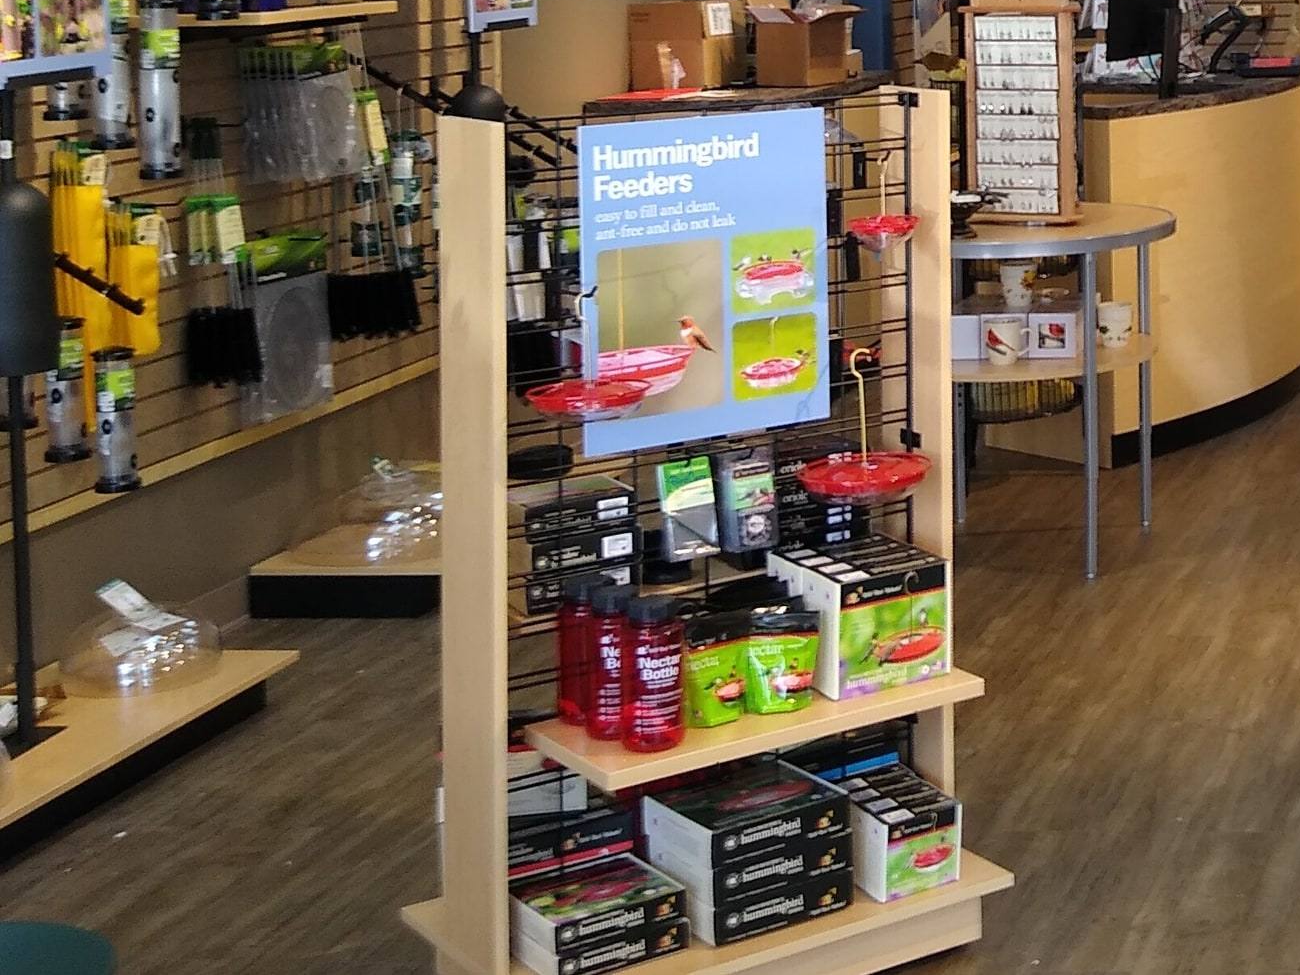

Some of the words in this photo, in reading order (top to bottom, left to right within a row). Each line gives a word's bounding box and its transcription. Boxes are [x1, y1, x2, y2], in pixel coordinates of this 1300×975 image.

[592, 131, 760, 172] Hummingbird
[593, 170, 694, 202] Feeders
[594, 211, 624, 225] easy
[624, 209, 638, 221] to
[640, 203, 658, 219] fill
[660, 201, 684, 217] and
[595, 223, 646, 241] ant-free
[646, 220, 670, 235] and
[671, 216, 689, 233] do
[690, 218, 710, 230] not
[711, 213, 737, 227] leak
[637, 653, 682, 670] Nectar
[641, 665, 680, 681] Bottle
[741, 816, 802, 845] hummingbird
[743, 854, 804, 883] hummingbird
[579, 906, 645, 937] hummingbird
[743, 893, 805, 923] hummingbird
